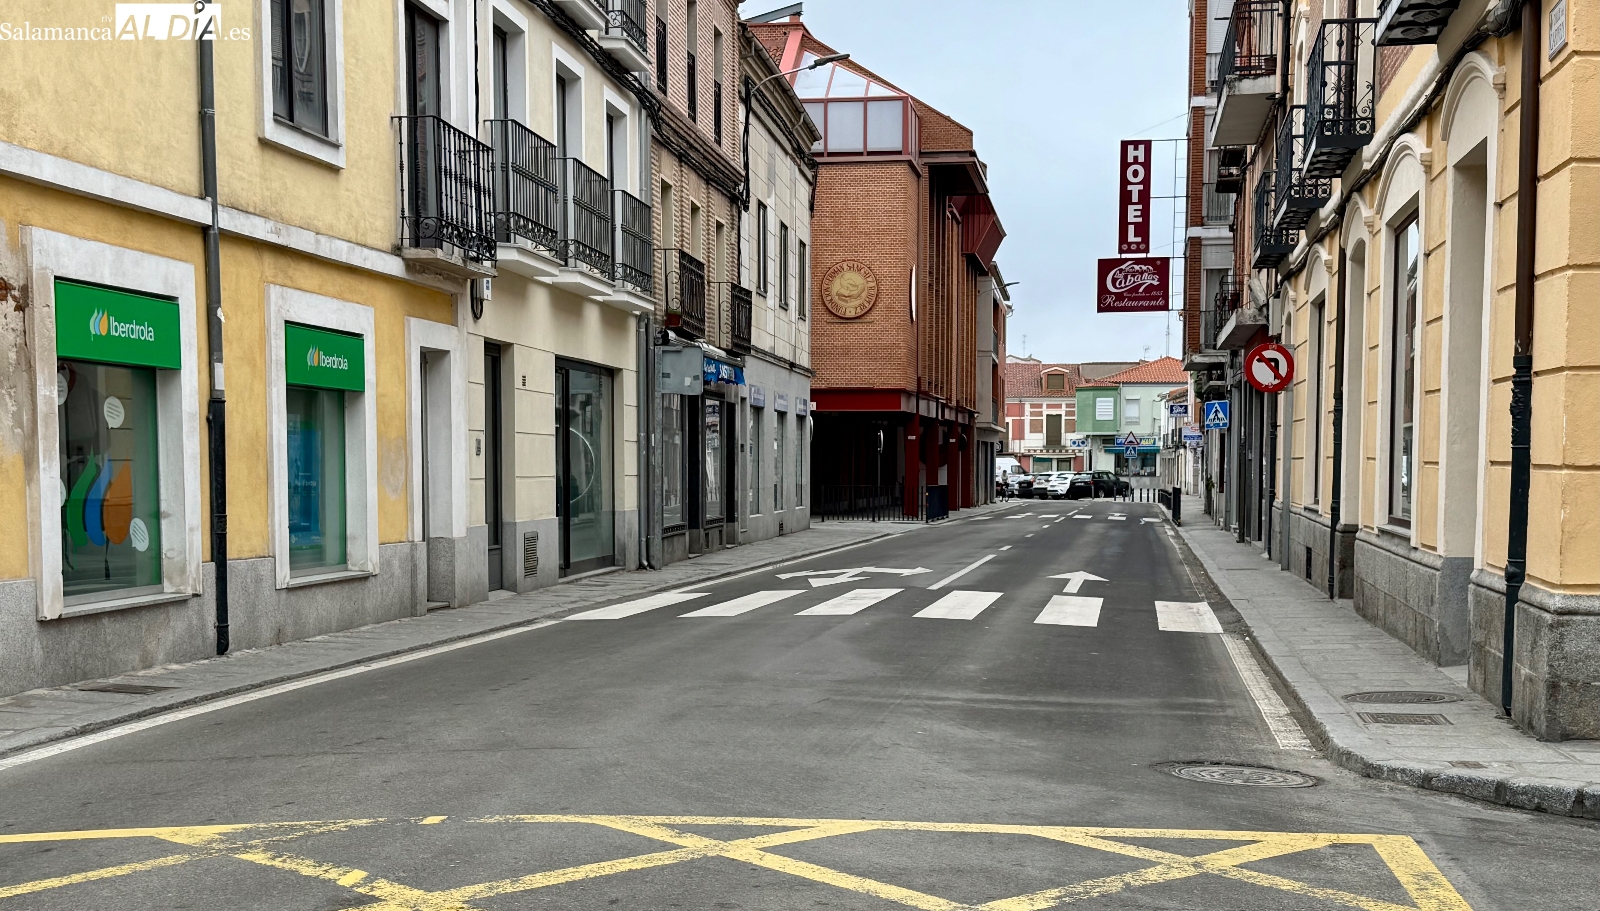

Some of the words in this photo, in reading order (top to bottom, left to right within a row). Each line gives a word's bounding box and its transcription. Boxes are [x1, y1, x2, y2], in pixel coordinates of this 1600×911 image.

[1126, 144, 1145, 243] HOTEL
[1100, 294, 1166, 308] Restaurante
[110, 315, 155, 342] Iberdrola
[319, 350, 349, 371] Iberdrola
